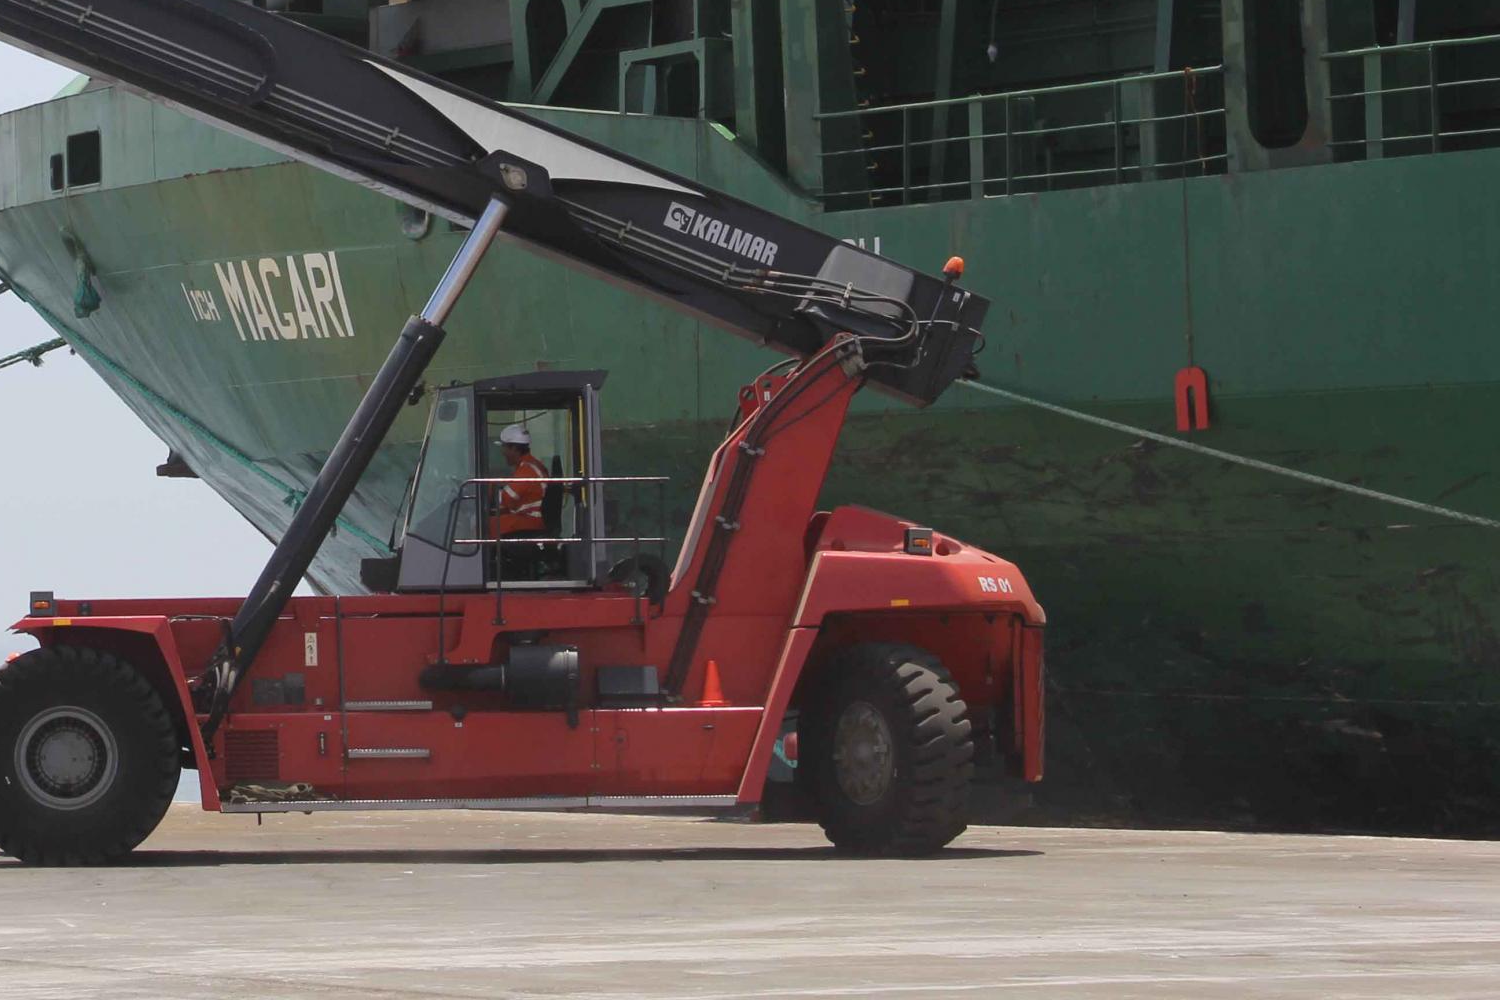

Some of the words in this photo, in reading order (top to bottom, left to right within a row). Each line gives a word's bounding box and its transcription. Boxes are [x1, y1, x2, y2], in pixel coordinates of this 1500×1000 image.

[691, 214, 779, 266] KALMAR
[213, 250, 355, 341] MAGARI
[978, 576, 998, 592] RS
